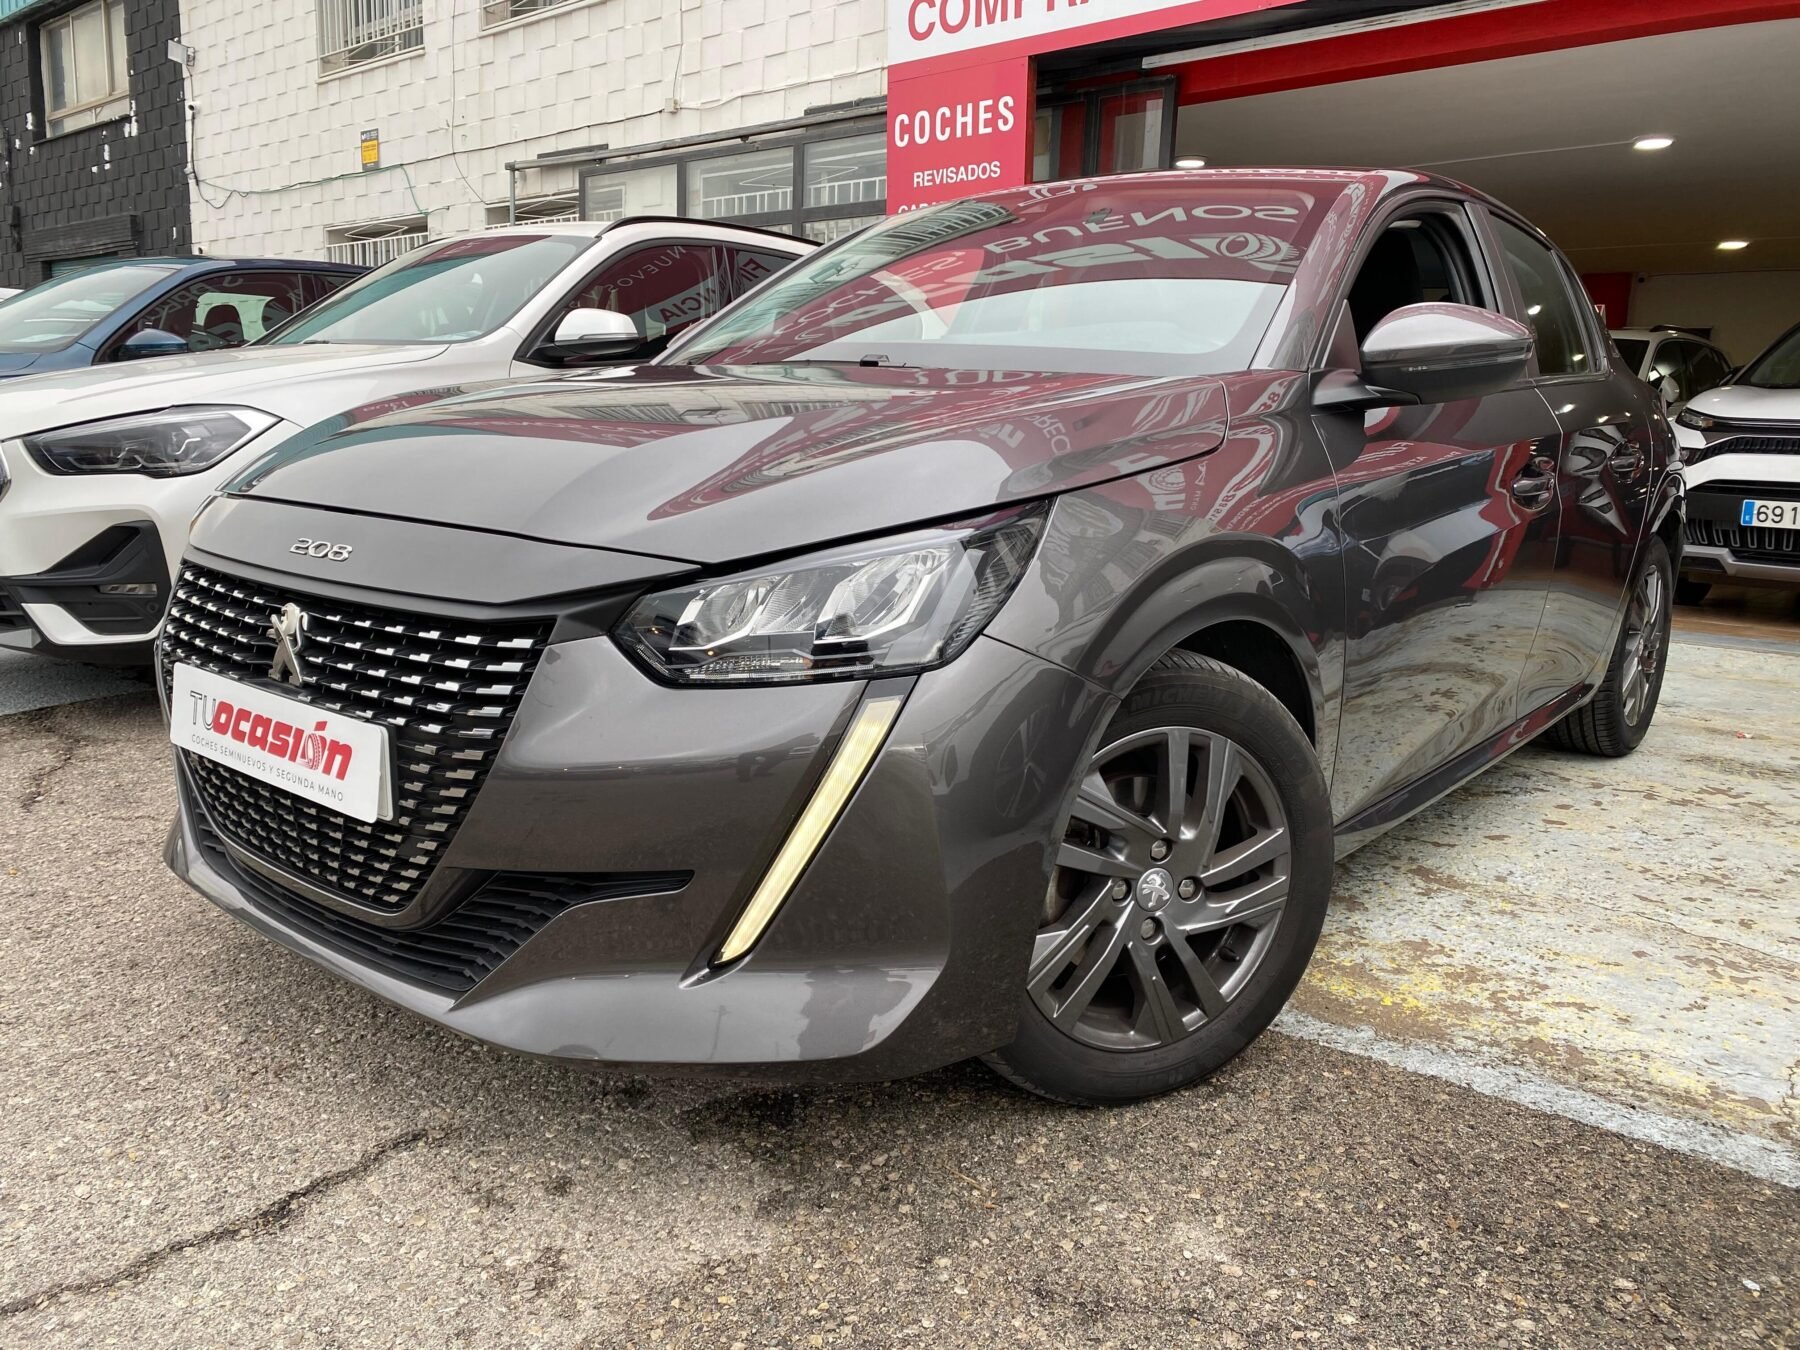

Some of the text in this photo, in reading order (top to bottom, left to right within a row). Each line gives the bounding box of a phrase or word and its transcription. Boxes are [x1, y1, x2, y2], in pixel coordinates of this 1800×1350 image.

[908, 0, 1091, 41] COM
[894, 95, 1015, 148] COCHES
[913, 160, 1001, 188] REVISADOS
[1756, 504, 1799, 526] 691
[289, 537, 353, 562] 208
[191, 734, 344, 802] COCHES SEMINUEVOS Y SEGUNDA MANO
